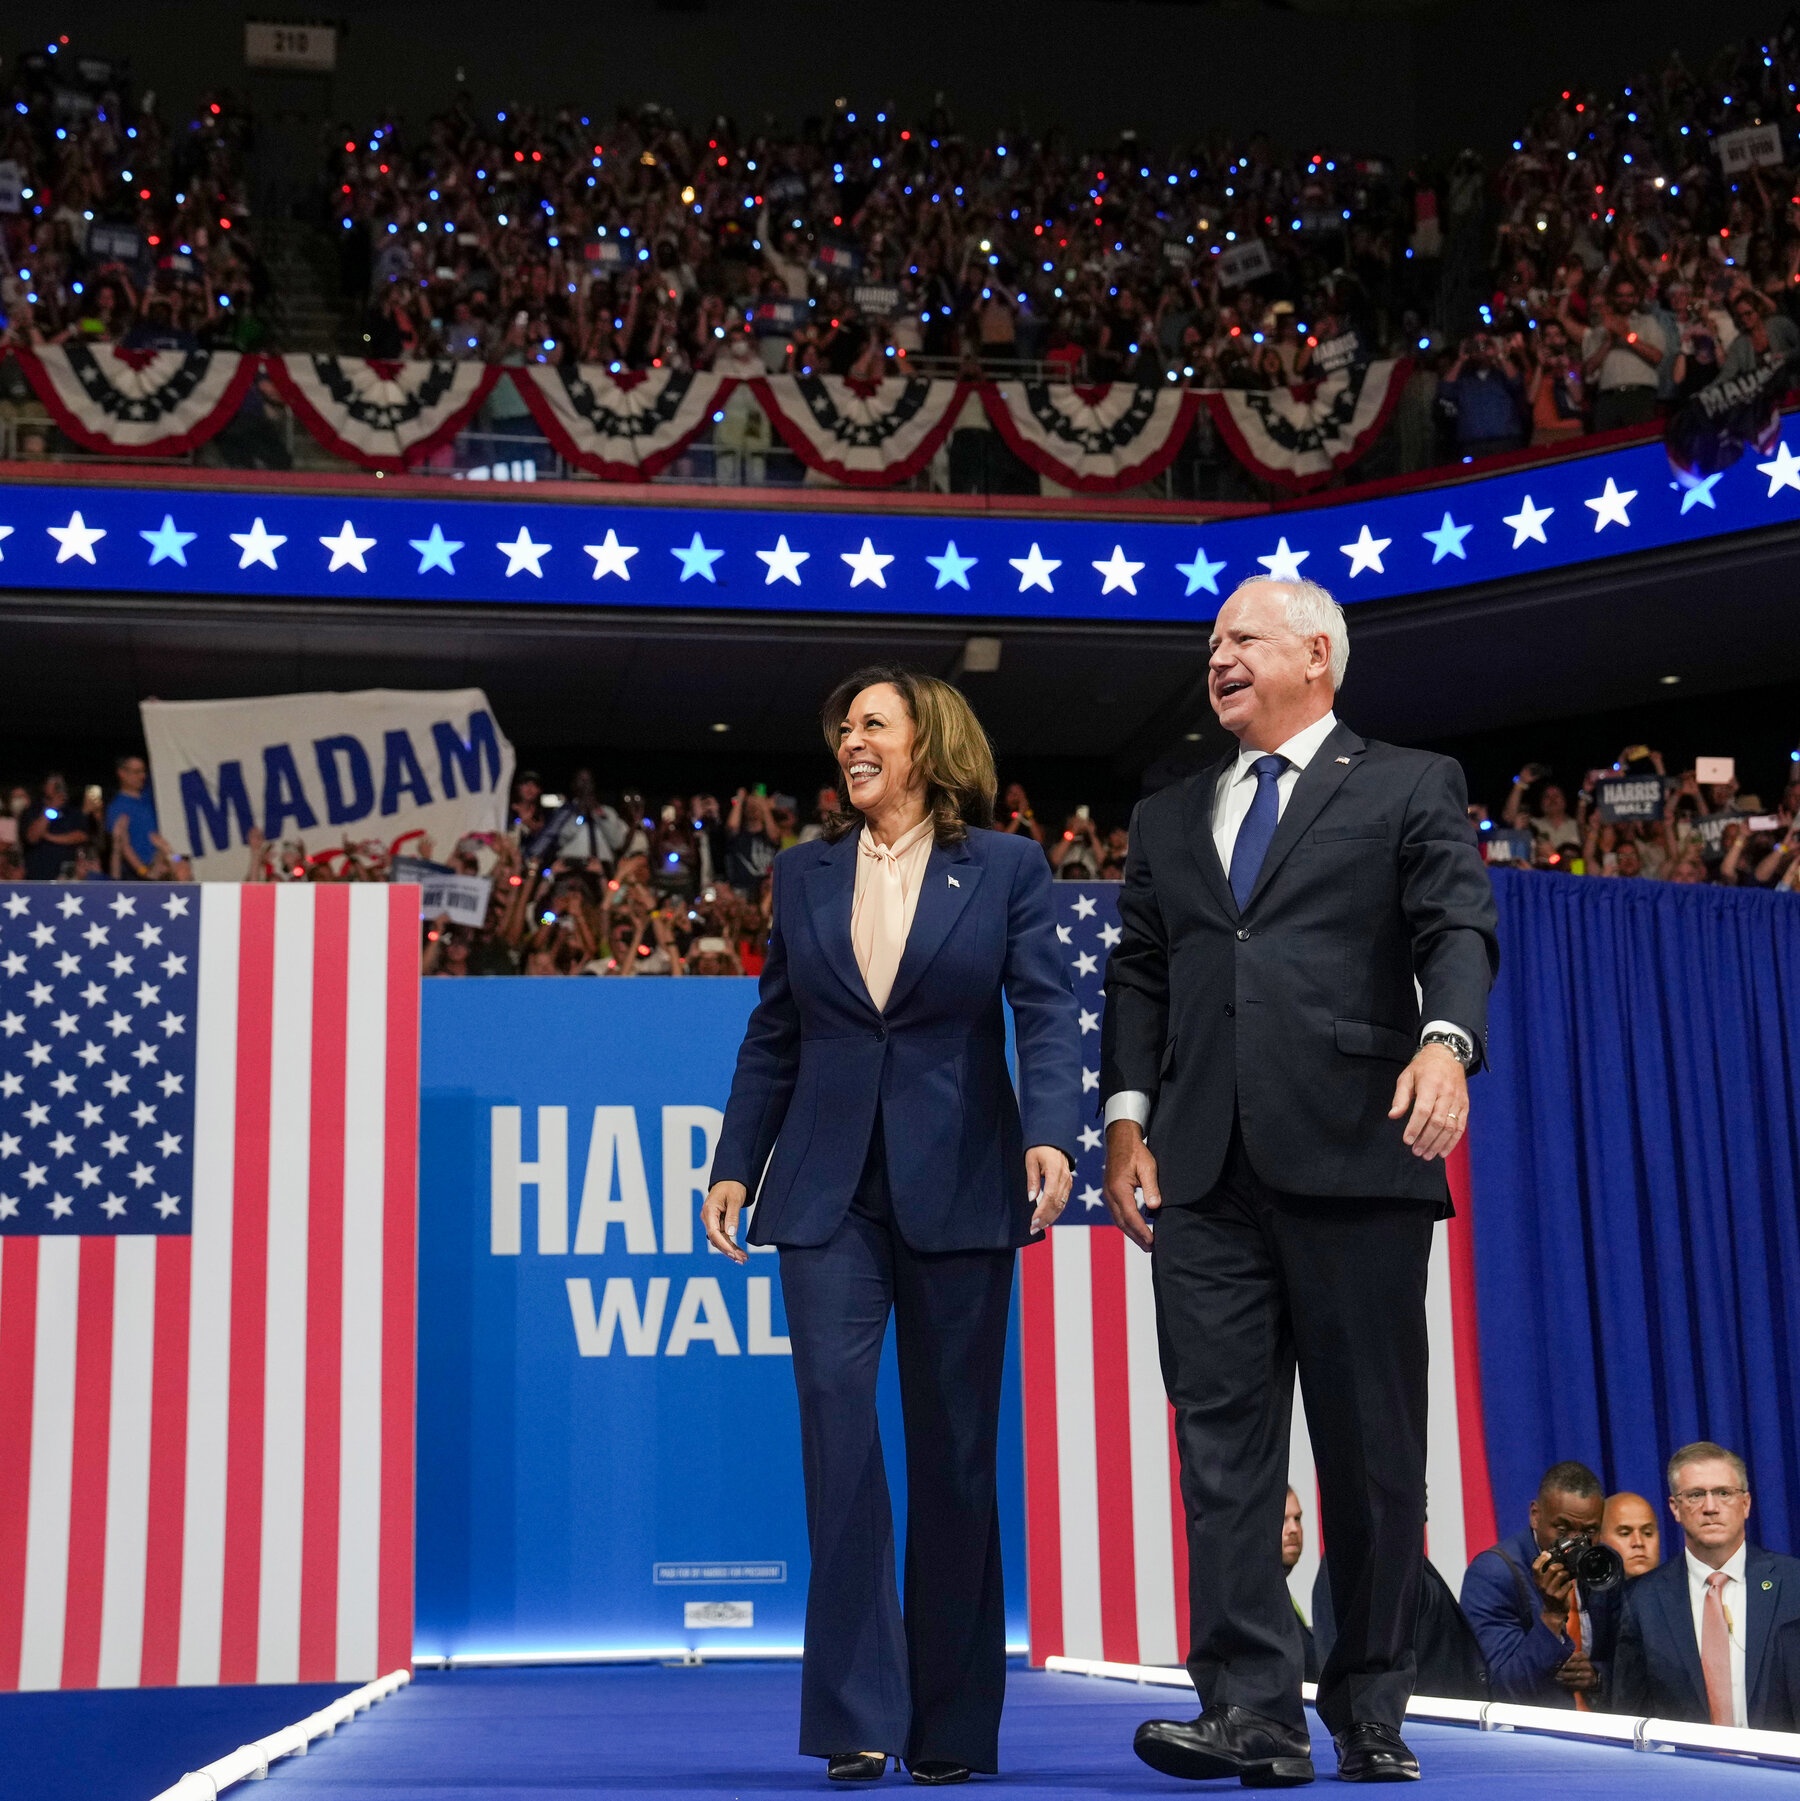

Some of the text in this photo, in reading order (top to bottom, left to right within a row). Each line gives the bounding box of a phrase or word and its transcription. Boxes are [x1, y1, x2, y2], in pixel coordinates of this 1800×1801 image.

[180, 709, 501, 858] MADAM
[1603, 781, 1660, 805] HARRIS
[1613, 802, 1653, 815] WALZ
[491, 1105, 777, 1255] HAR
[744, 1566, 779, 1577] PRESIDENT
